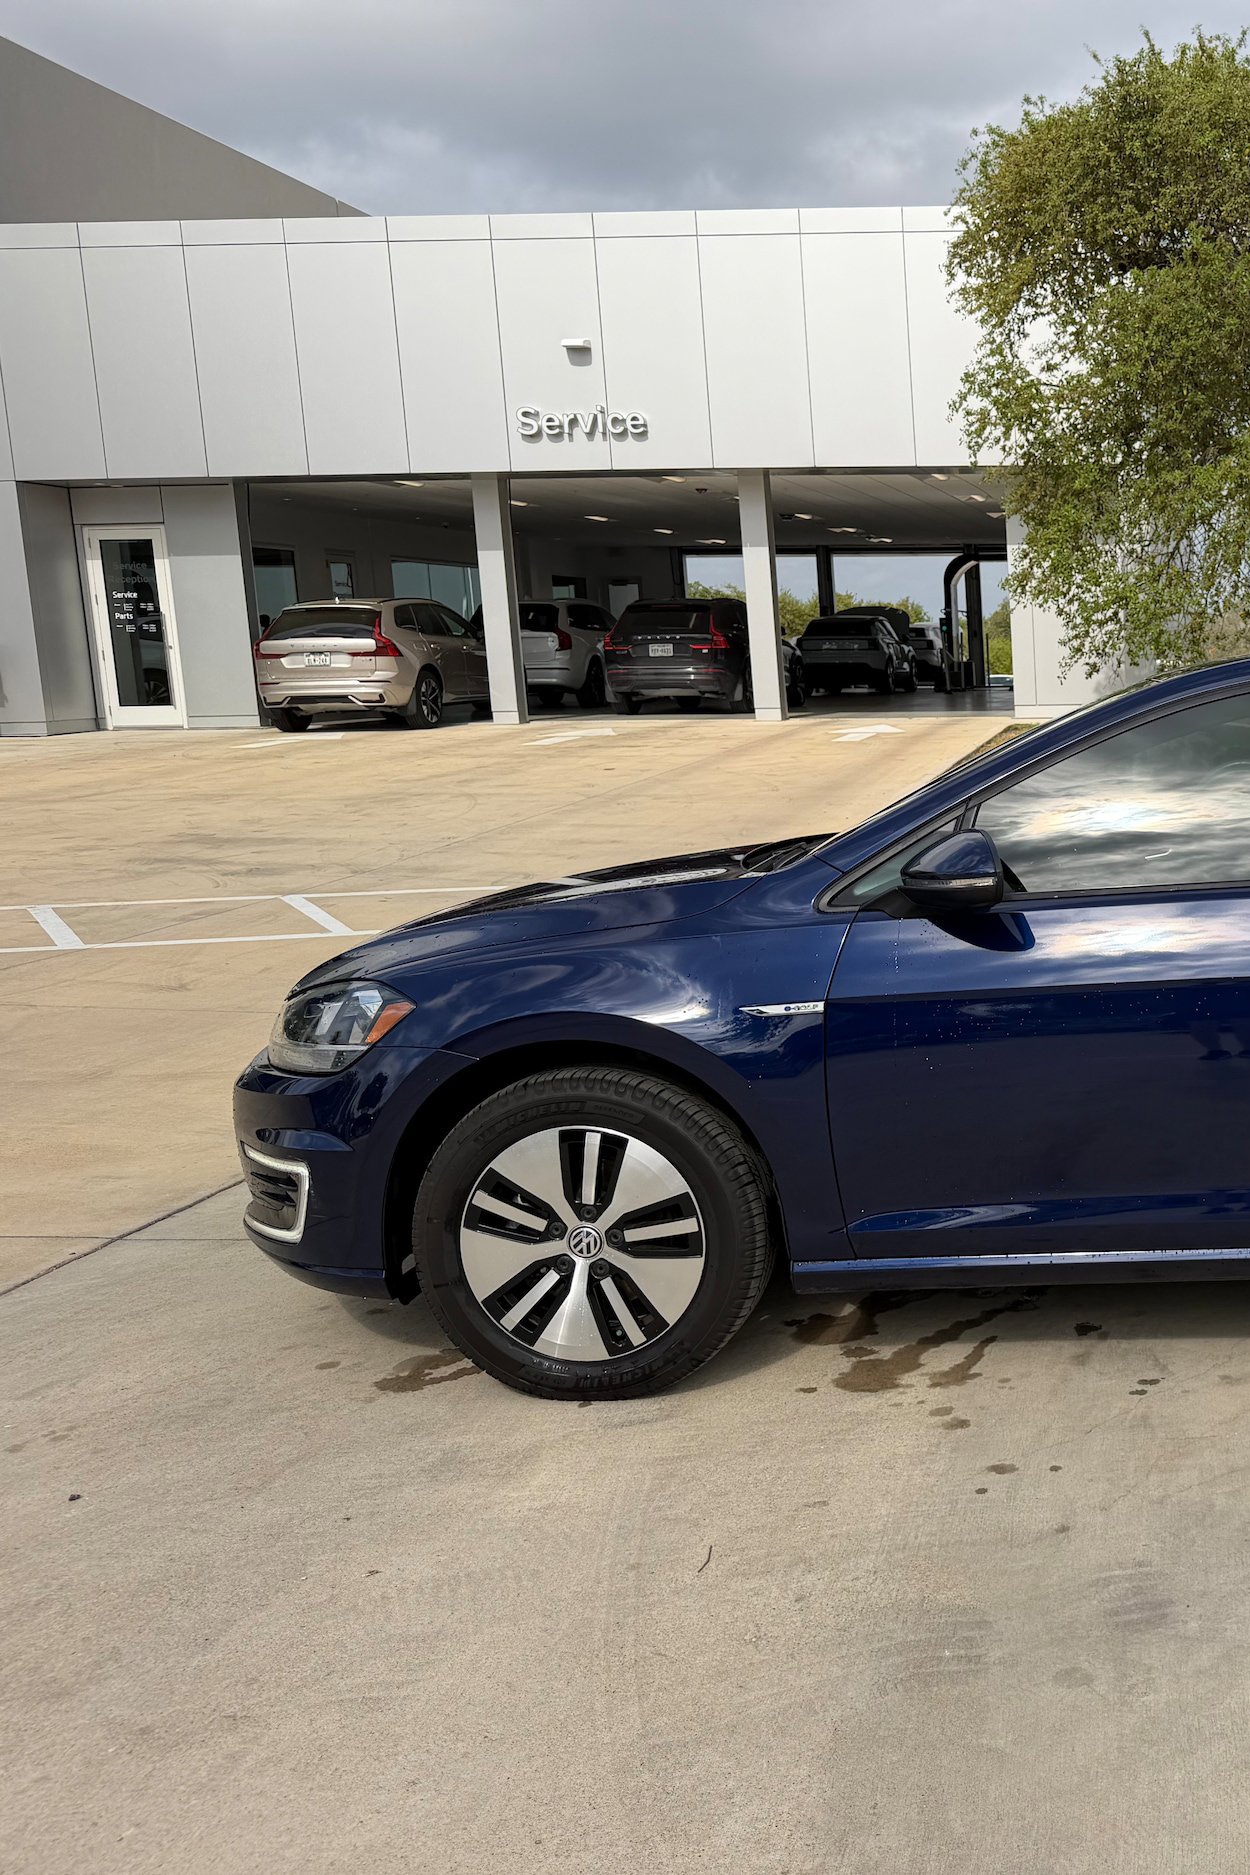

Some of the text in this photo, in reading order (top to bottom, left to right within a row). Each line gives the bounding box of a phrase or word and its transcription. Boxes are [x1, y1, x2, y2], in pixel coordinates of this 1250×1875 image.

[516, 405, 647, 437] Service
[112, 591, 138, 599] Service
[115, 612, 134, 620] Parts
